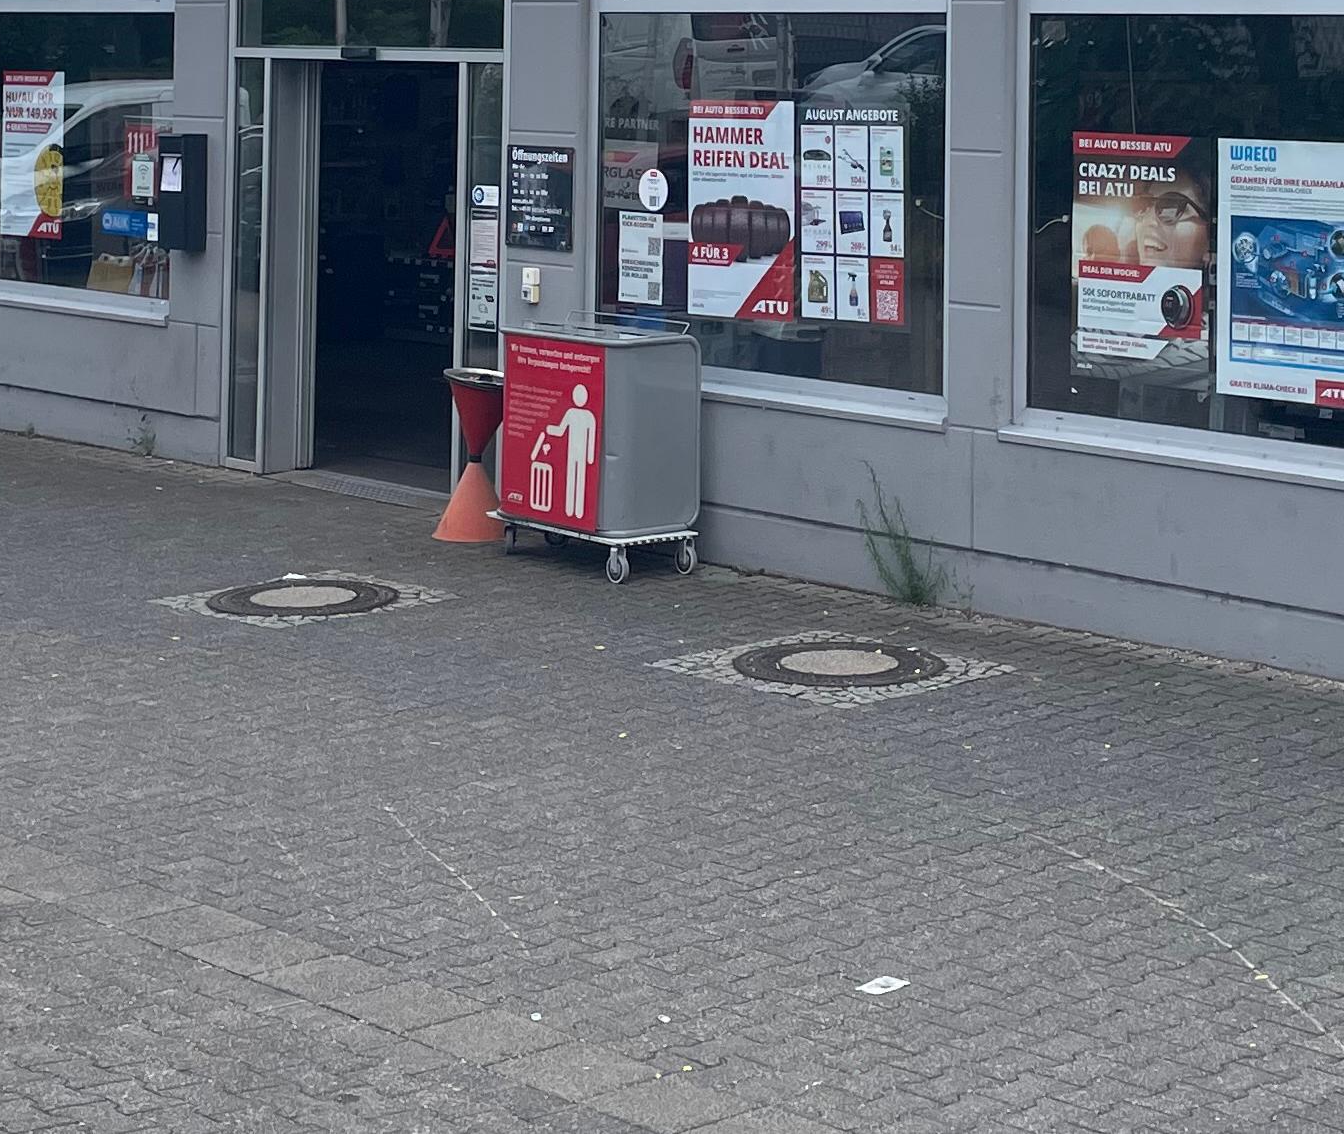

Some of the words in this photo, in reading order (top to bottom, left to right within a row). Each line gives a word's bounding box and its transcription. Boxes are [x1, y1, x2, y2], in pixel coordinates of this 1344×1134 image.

[6, 92, 33, 103] HU/AU
[6, 106, 24, 118] NUR
[27, 107, 57, 120] 149,99€
[693, 106, 703, 114] BEI
[705, 106, 723, 114] AUTO
[725, 106, 748, 114] BESSER
[805, 109, 844, 121] AUGUST
[846, 110, 898, 121] ANGEBOTE
[693, 126, 764, 145] HAMMER
[1079, 139, 1092, 148] BEI
[1094, 140, 1118, 149] AUTO
[1120, 141, 1151, 151] BESSER
[1154, 143, 1172, 152] ATU
[512, 147, 568, 164] Öffnungszeiten
[693, 150, 744, 168] REIFEN
[750, 151, 789, 169] DEAL
[1230, 145, 1276, 162] WAECO
[1079, 162, 1126, 179] CRAZY
[1130, 165, 1176, 182] DEALS
[1079, 180, 1101, 195] BEI
[1105, 182, 1134, 197] ATU
[37, 222, 59, 234] ATU
[692, 246, 698, 258] 4
[701, 244, 720, 258] FÜR
[722, 248, 729, 259] 3
[1100, 267, 1113, 275] DER
[1097, 289, 1156, 302] SOFORTRABATT
[752, 299, 788, 315] ATU
